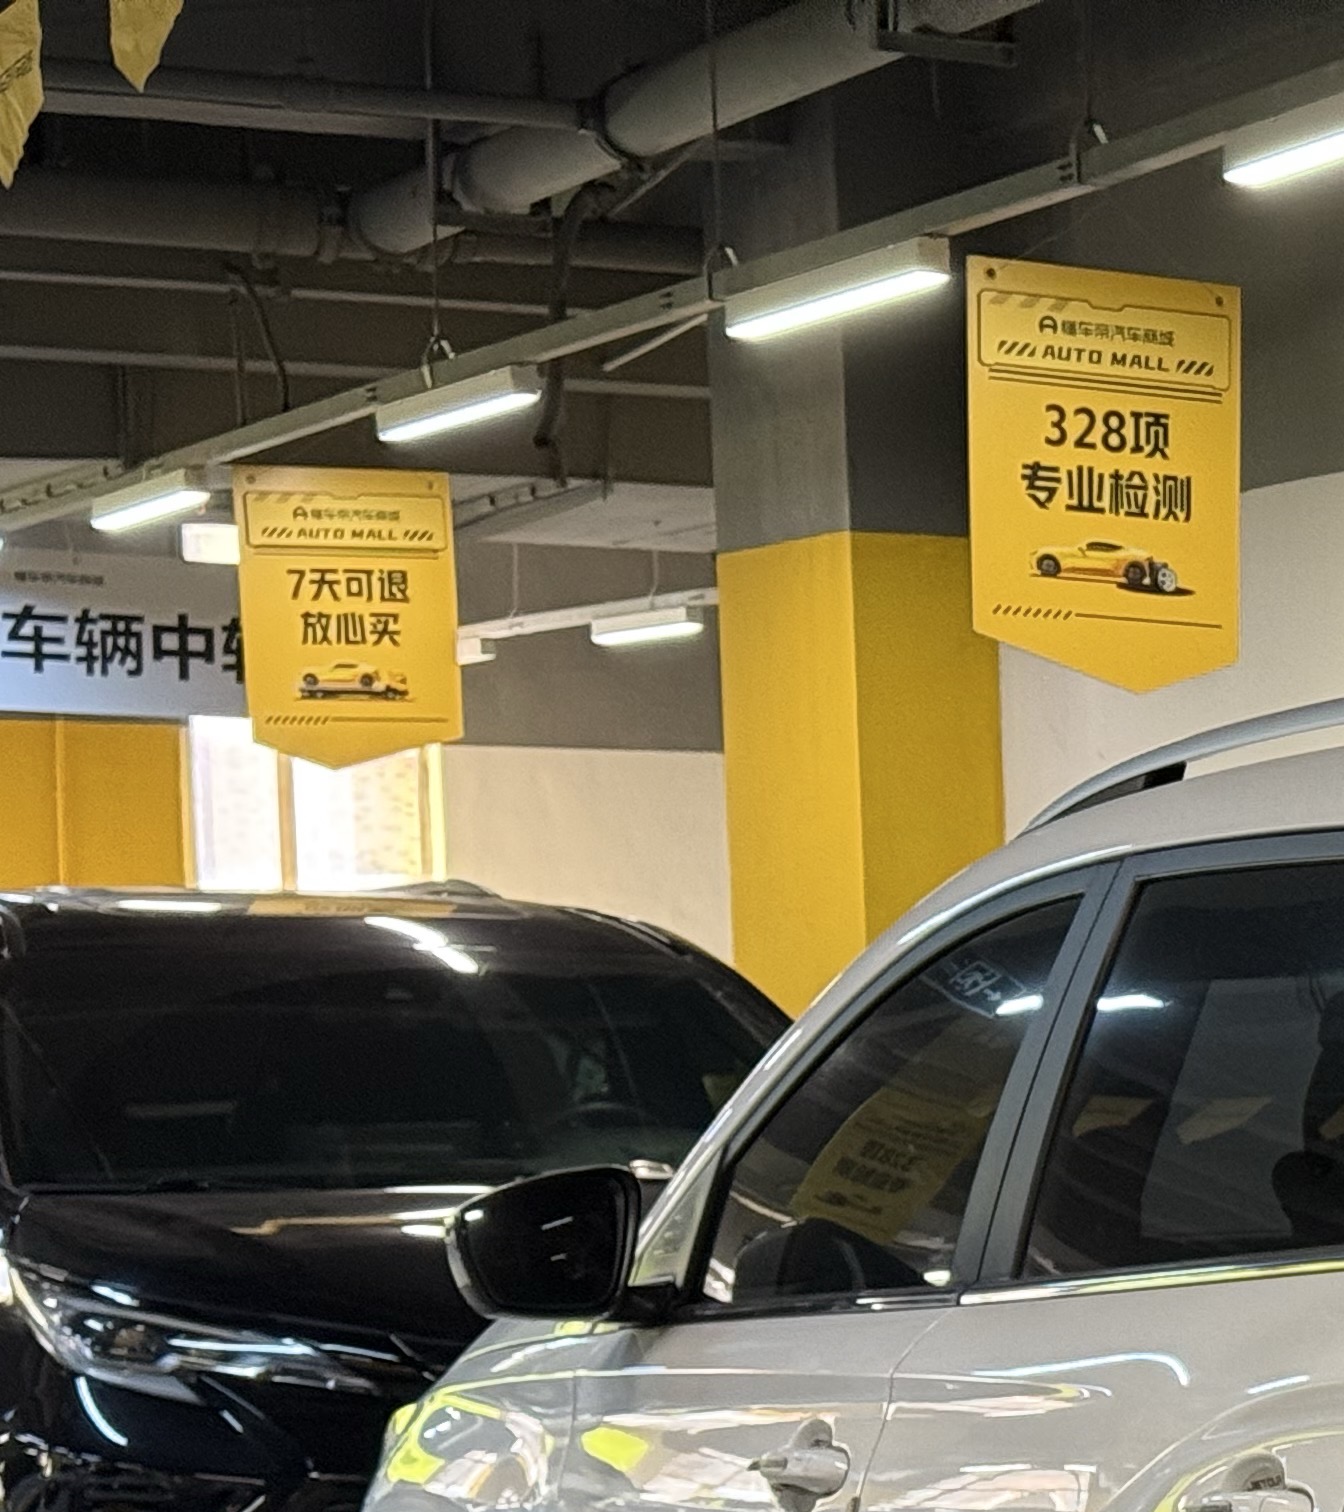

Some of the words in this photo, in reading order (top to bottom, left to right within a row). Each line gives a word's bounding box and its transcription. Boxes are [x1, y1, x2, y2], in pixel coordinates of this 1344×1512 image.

[1042, 344, 1103, 365] AUTO
[1110, 351, 1170, 373] MALL
[1043, 403, 1171, 461] 328项
[1020, 460, 1193, 524] 专业检测
[297, 527, 345, 540] AUTO
[351, 527, 399, 541] MALL
[286, 568, 411, 604] 7天可退
[300, 611, 402, 648] 放心买
